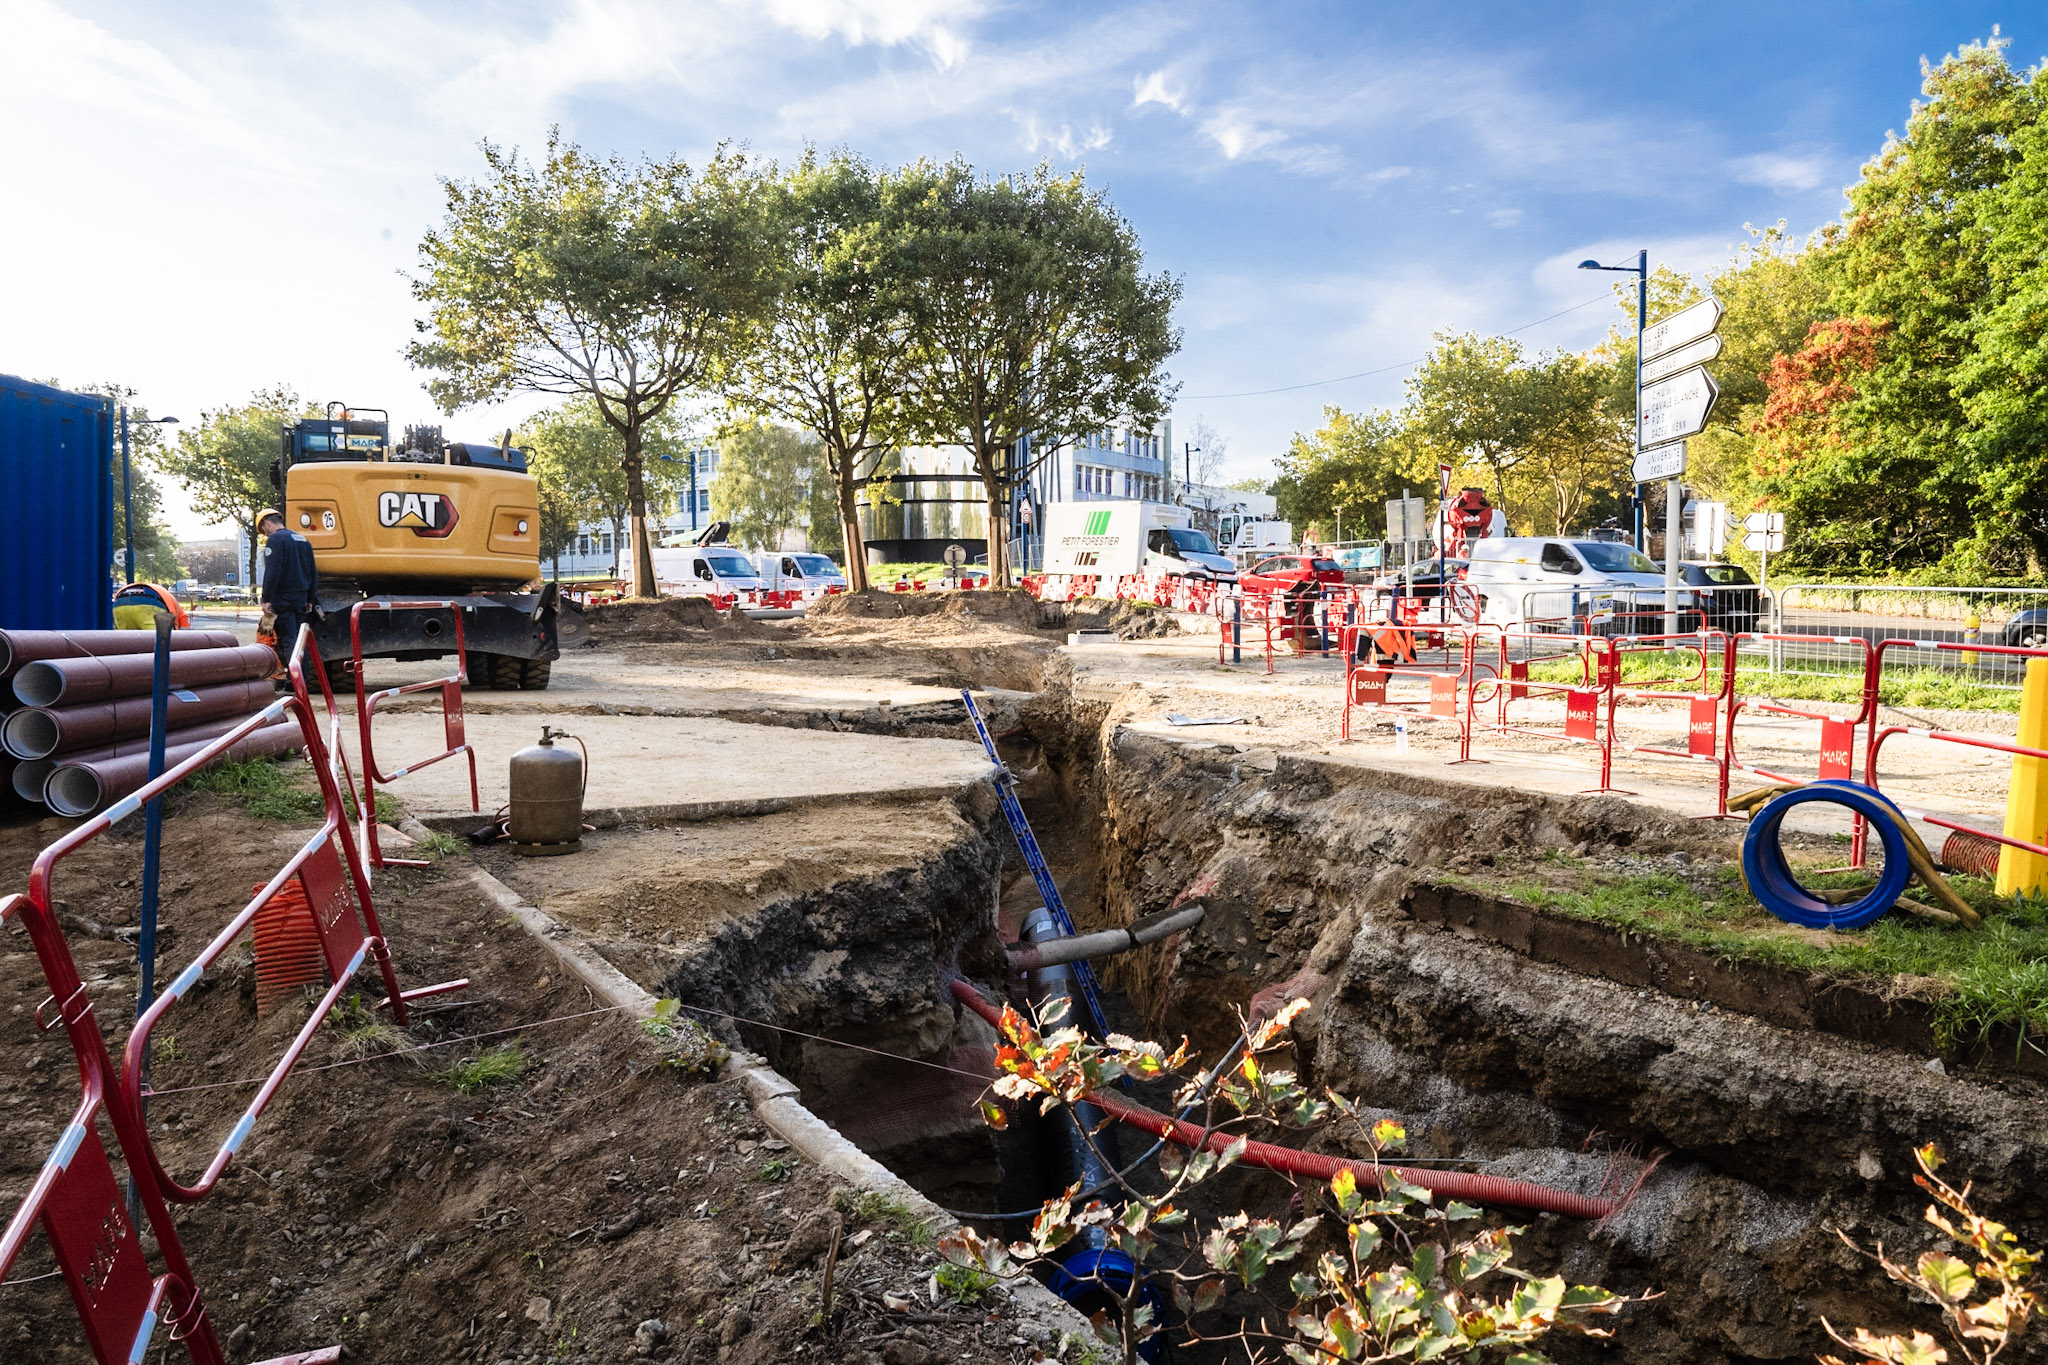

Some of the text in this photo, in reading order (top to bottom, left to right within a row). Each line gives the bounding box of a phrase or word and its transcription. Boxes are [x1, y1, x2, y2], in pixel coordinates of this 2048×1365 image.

[380, 493, 440, 528] CAT
[324, 513, 334, 529] 25
[1062, 536, 1119, 546] PETIT FORESTIER
[1690, 722, 1713, 734] MARC
[1822, 750, 1848, 766] MARC
